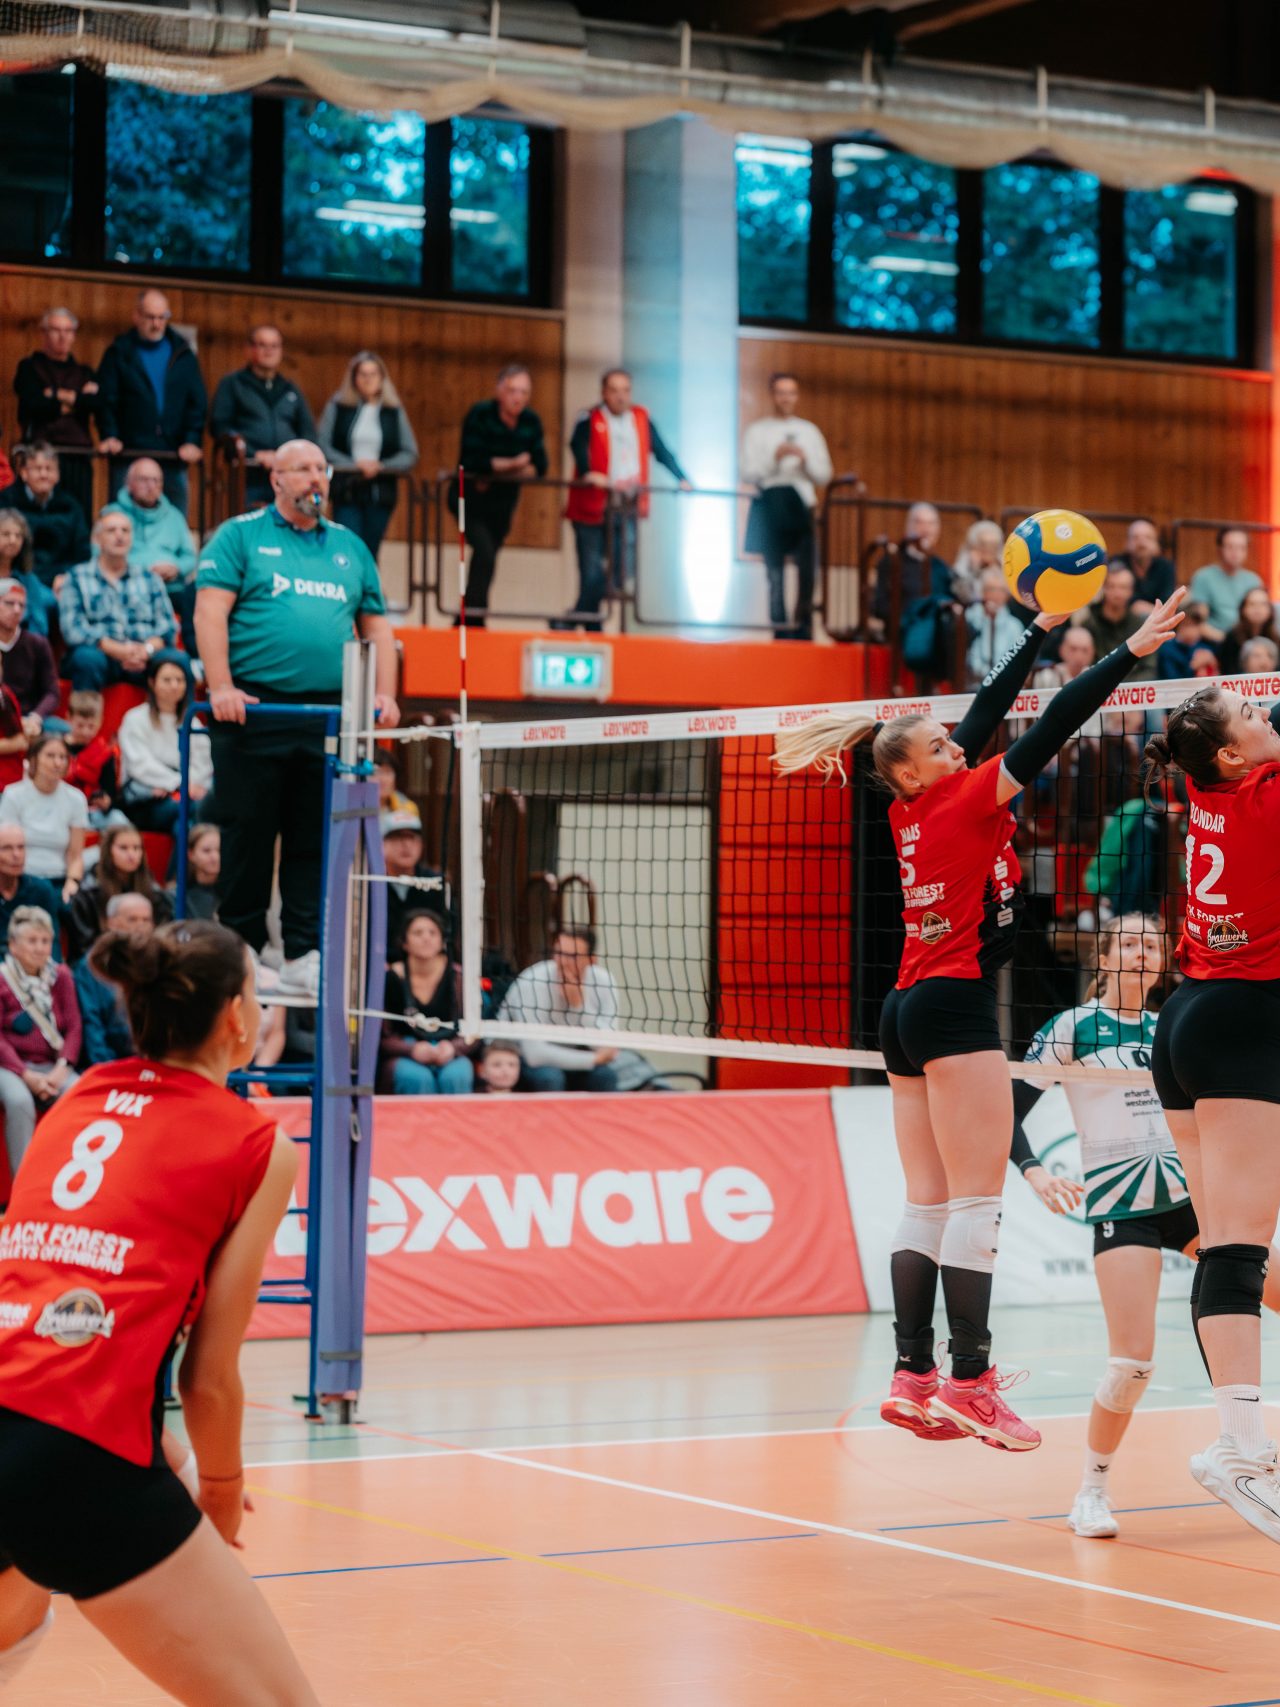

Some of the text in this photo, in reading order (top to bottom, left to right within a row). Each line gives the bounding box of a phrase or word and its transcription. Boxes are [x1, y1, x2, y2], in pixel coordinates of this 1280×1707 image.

[294, 578, 347, 603] DEKRA
[982, 629, 1033, 688] Lexware
[1101, 686, 1156, 707] xware
[523, 725, 566, 741] Lexware
[603, 720, 649, 737] Lexware
[688, 715, 737, 733] Lexware
[103, 1089, 153, 1117] VIX
[52, 1119, 124, 1211] 8
[0, 1220, 135, 1261] LACK FOREST
